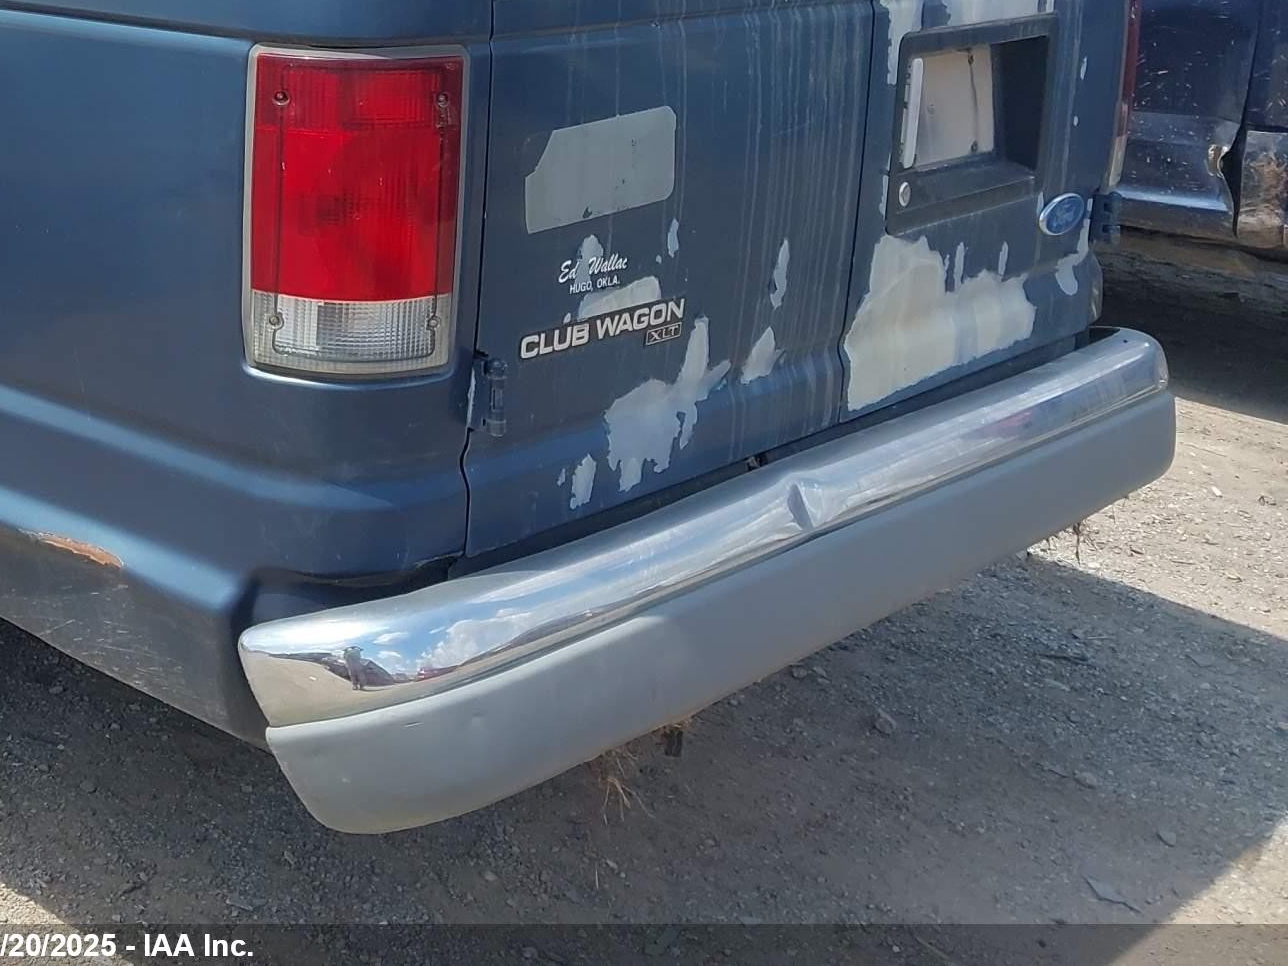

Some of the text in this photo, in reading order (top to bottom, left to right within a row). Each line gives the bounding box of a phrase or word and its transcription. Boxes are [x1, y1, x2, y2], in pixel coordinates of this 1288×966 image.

[558, 259, 580, 284] Ed
[569, 275, 620, 294] HUGO, OKLA.
[520, 298, 685, 360] CLUB WAGON
[649, 325, 679, 342] XLT
